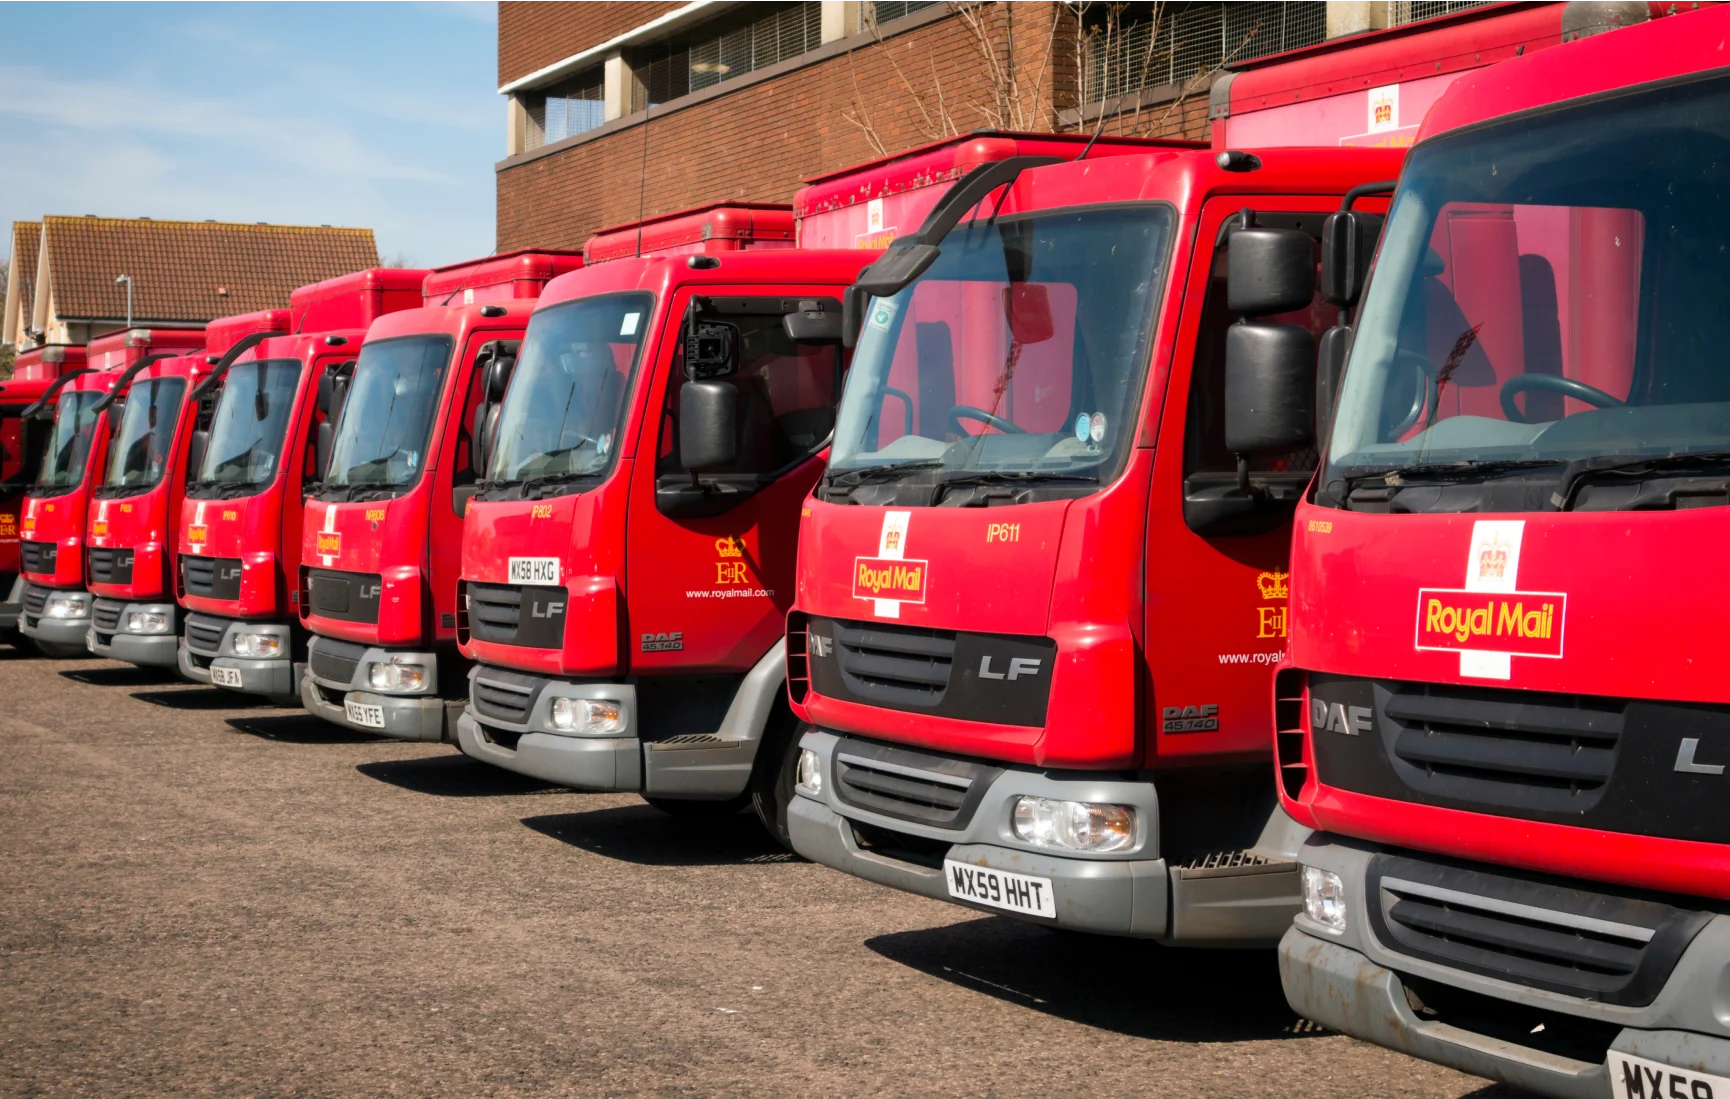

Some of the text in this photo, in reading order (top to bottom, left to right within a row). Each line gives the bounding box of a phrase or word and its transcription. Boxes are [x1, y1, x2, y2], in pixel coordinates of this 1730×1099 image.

[986, 523, 1020, 543] IP611
[117, 557, 134, 567] LF
[221, 568, 241, 579] LF
[534, 561, 554, 581] HXG
[858, 563, 921, 593] Royal Mail
[360, 585, 380, 599] LF
[686, 588, 774, 600] www.royalmail.com
[532, 602, 564, 618] LF
[1426, 598, 1554, 642] Royal Mail
[641, 632, 683, 642] DAF
[642, 642, 683, 651] 45.140
[978, 656, 1042, 681] LF
[1163, 704, 1218, 719] DAF
[1312, 698, 1372, 736] DAF
[1164, 719, 1218, 732] 45.140
[952, 866, 1043, 910] MX59 HHT
